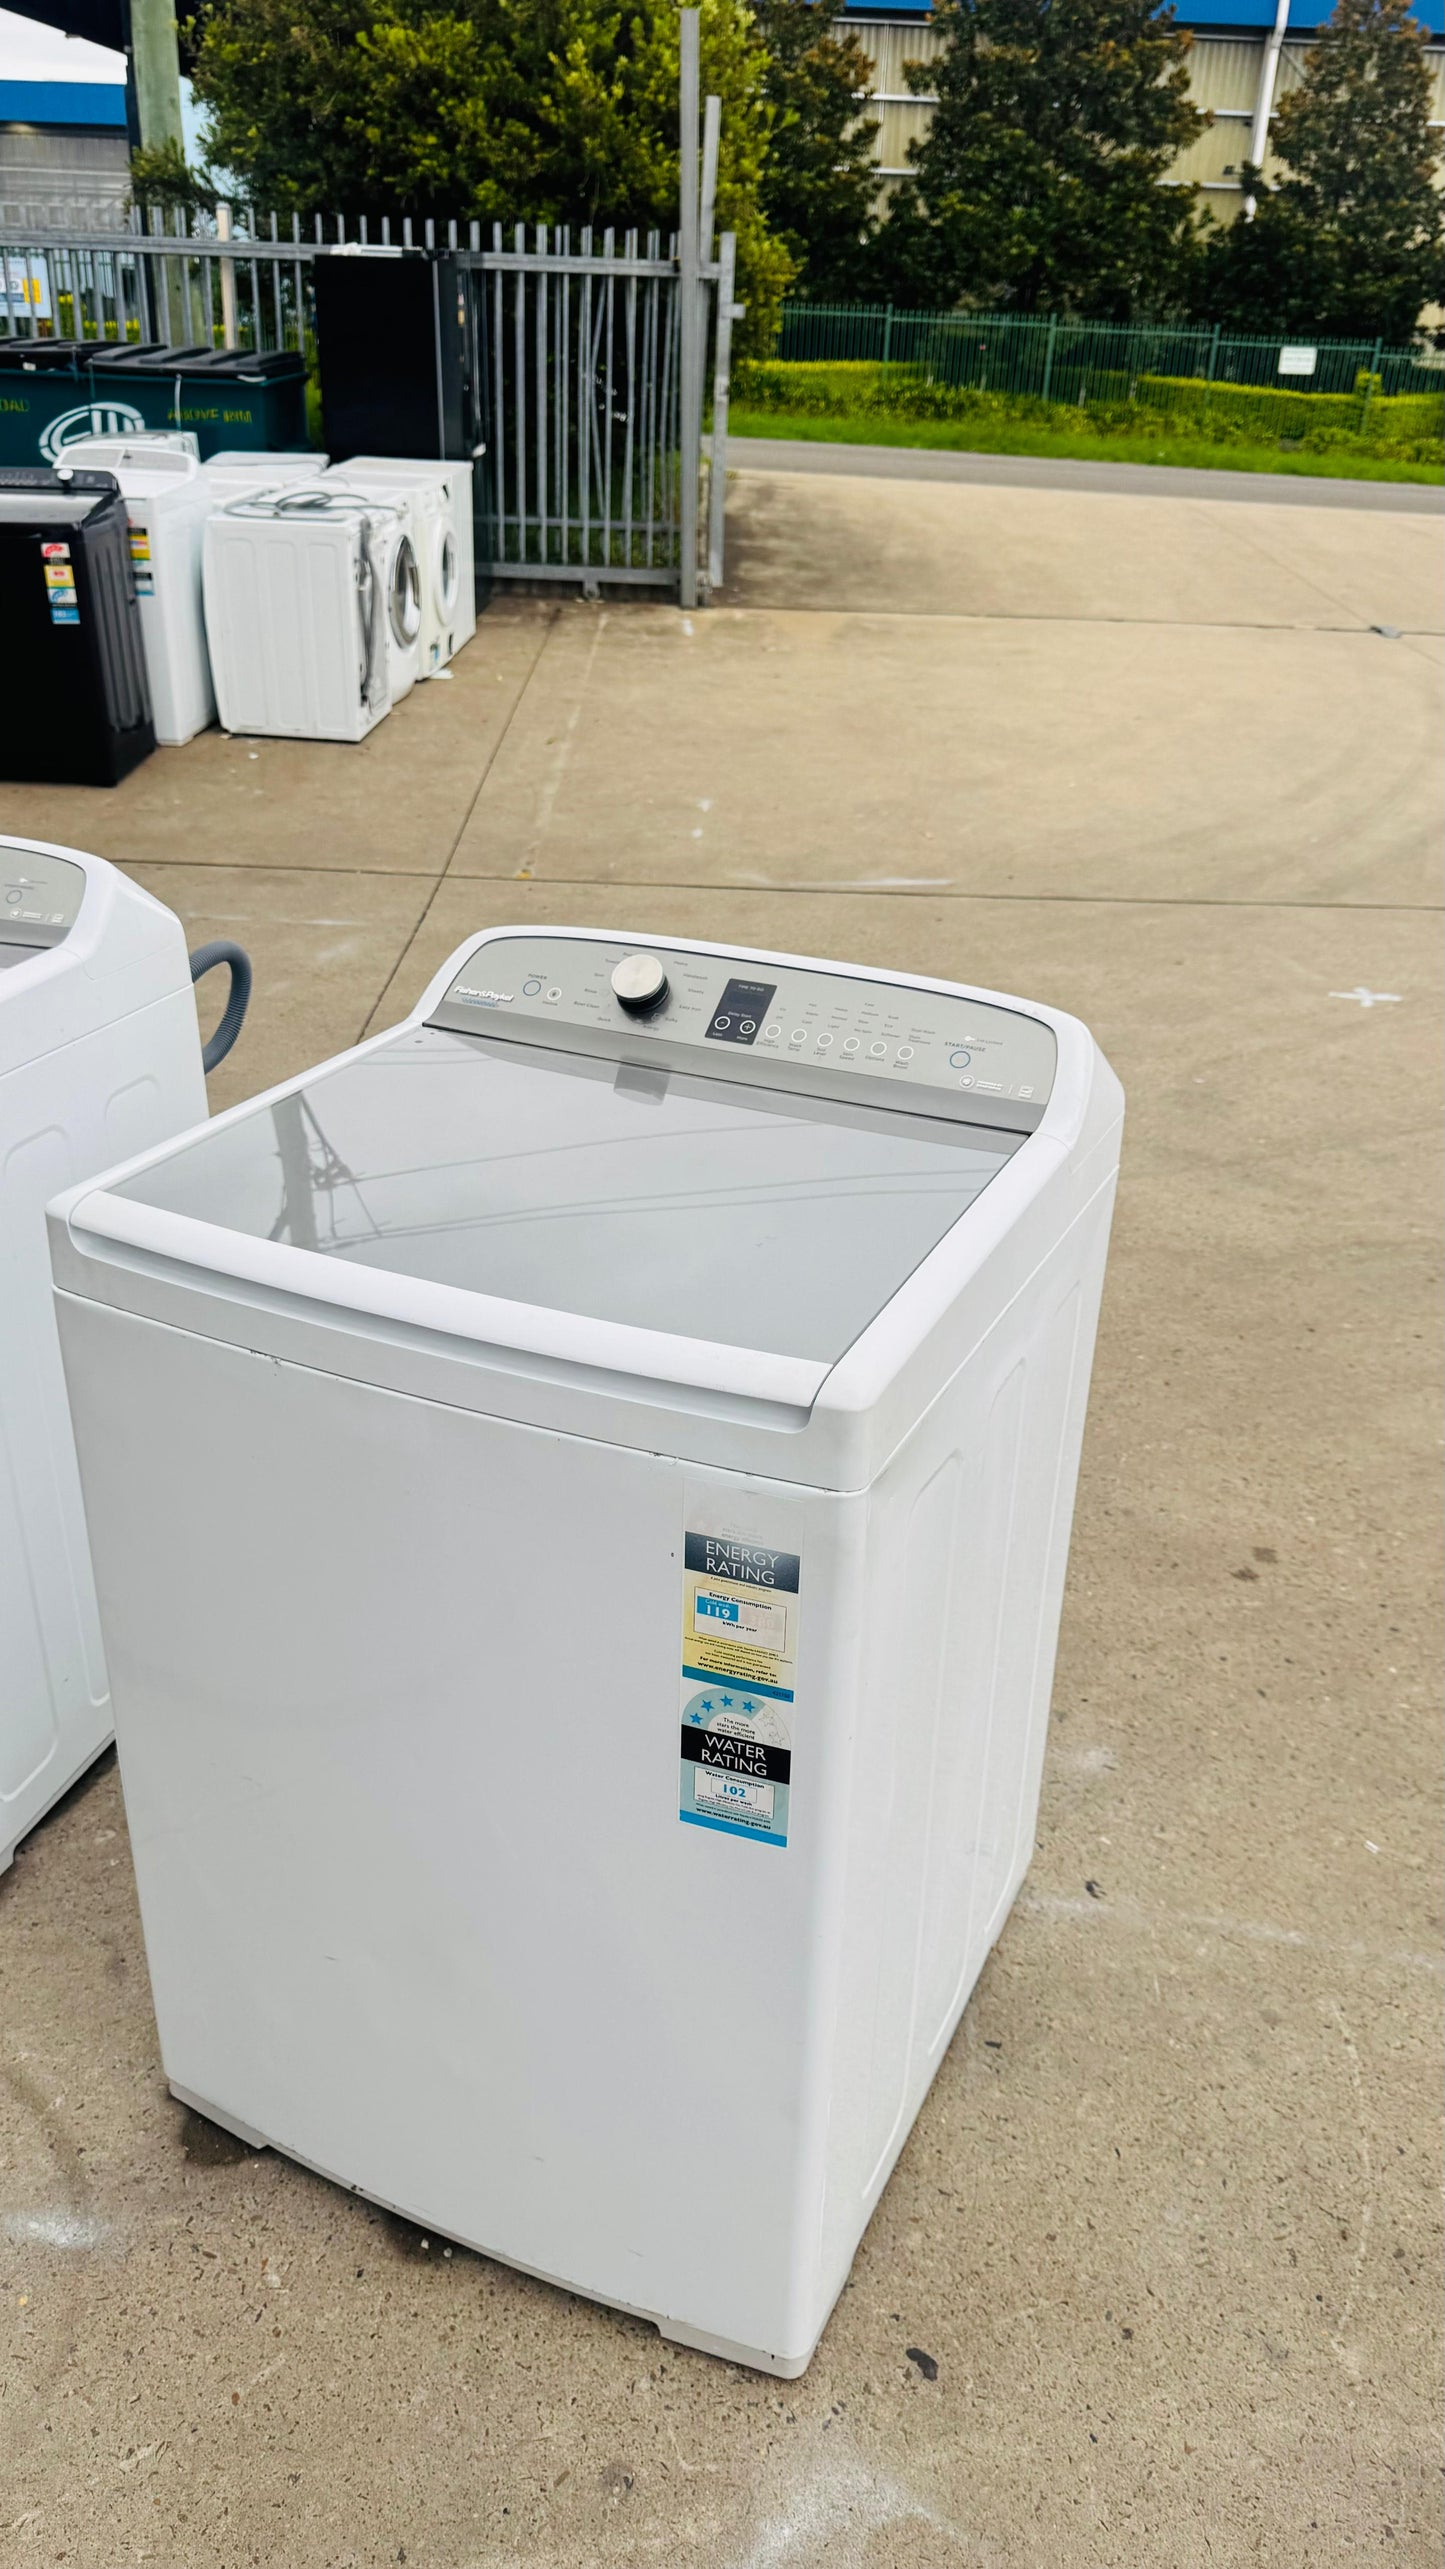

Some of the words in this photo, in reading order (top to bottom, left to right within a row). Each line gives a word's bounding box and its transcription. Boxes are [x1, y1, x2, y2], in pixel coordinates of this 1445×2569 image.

[706, 1540, 779, 1569] ENERGY
[706, 1557, 776, 1585] RATING
[706, 1605, 731, 1618] 119
[709, 1592, 730, 1602] Energy
[731, 1597, 772, 1611] Consumption
[697, 1662, 778, 1684] www.energyrating.gov.au
[733, 1731, 755, 1740] efficient
[704, 1734, 767, 1761] WATER
[701, 1748, 767, 1776] RATING
[705, 1771, 724, 1779] Water
[725, 1775, 765, 1789] Consumption
[723, 1784, 746, 1798] 102
[696, 1808, 772, 1830] www.waterrating.gov.au
